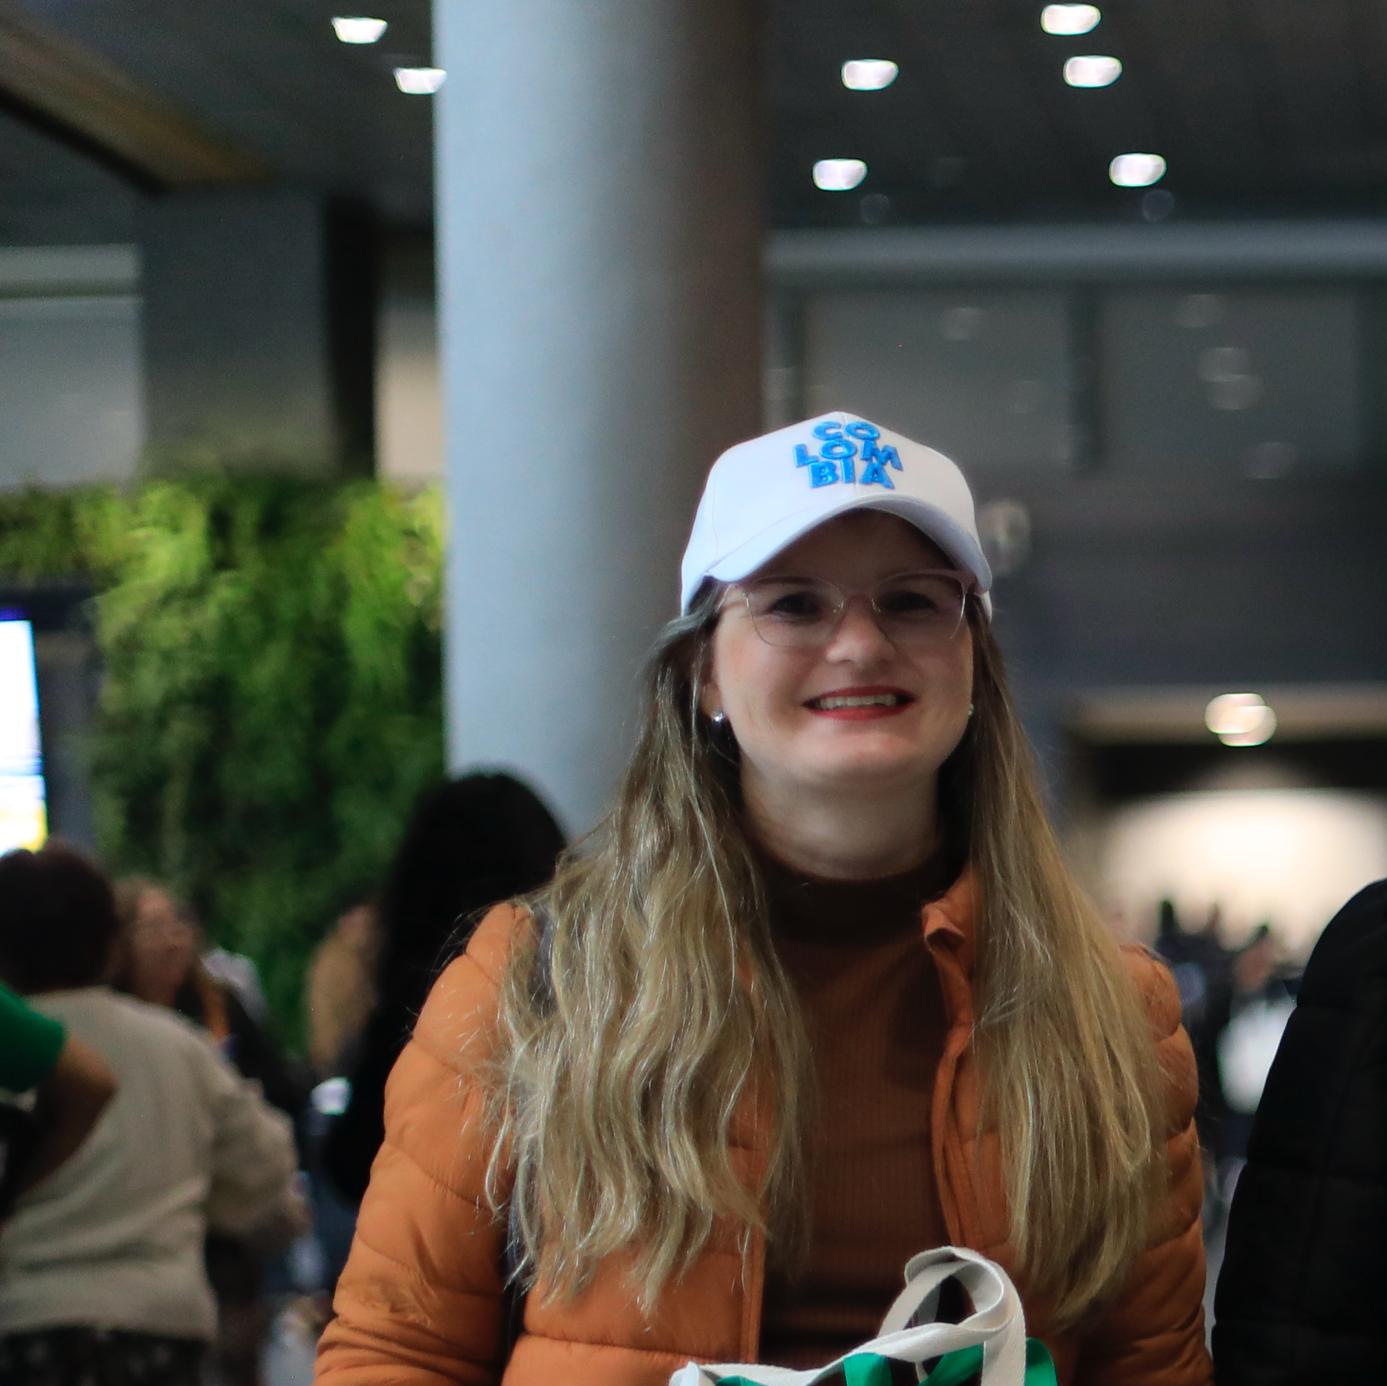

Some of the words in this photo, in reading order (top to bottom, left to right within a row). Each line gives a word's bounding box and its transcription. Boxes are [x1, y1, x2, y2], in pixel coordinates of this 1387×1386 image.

[812, 421, 880, 441] CO
[794, 439, 903, 471] LOM
[808, 460, 895, 489] BIA
